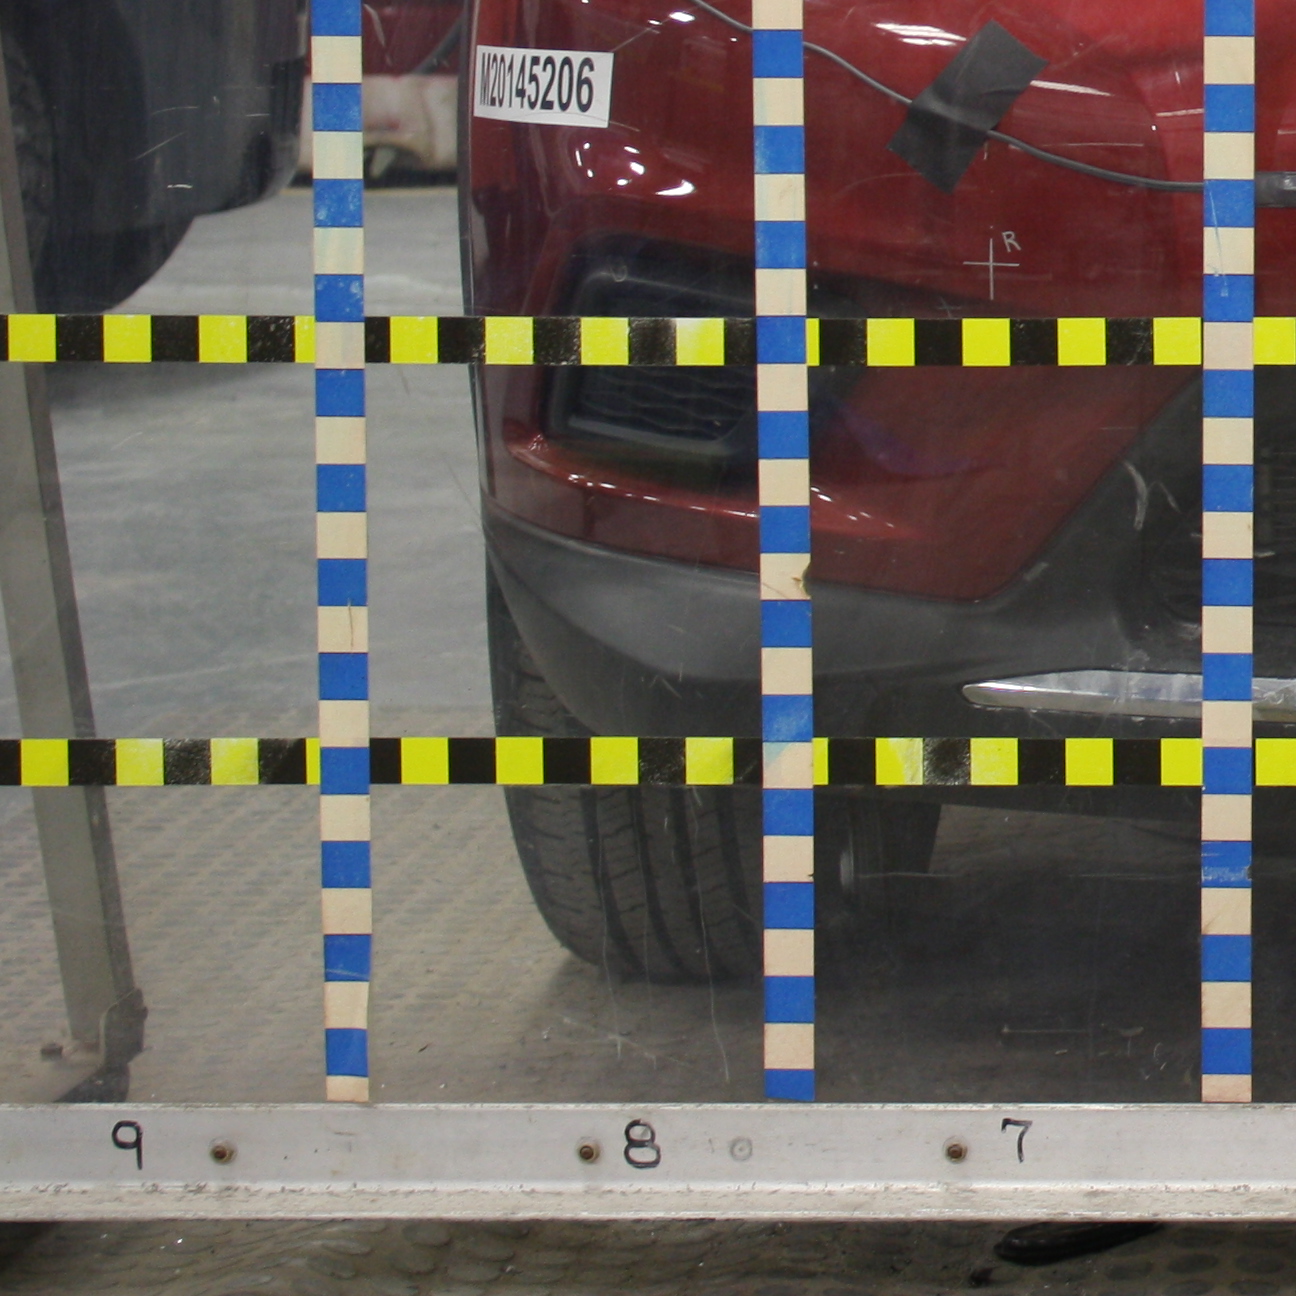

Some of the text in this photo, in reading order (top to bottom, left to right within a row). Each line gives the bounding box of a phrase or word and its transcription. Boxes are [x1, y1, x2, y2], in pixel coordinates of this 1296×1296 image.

[480, 51, 595, 113] M20145206
[111, 1120, 143, 1170] 9
[623, 1119, 661, 1170] 8
[1001, 1117, 1032, 1163] 7
